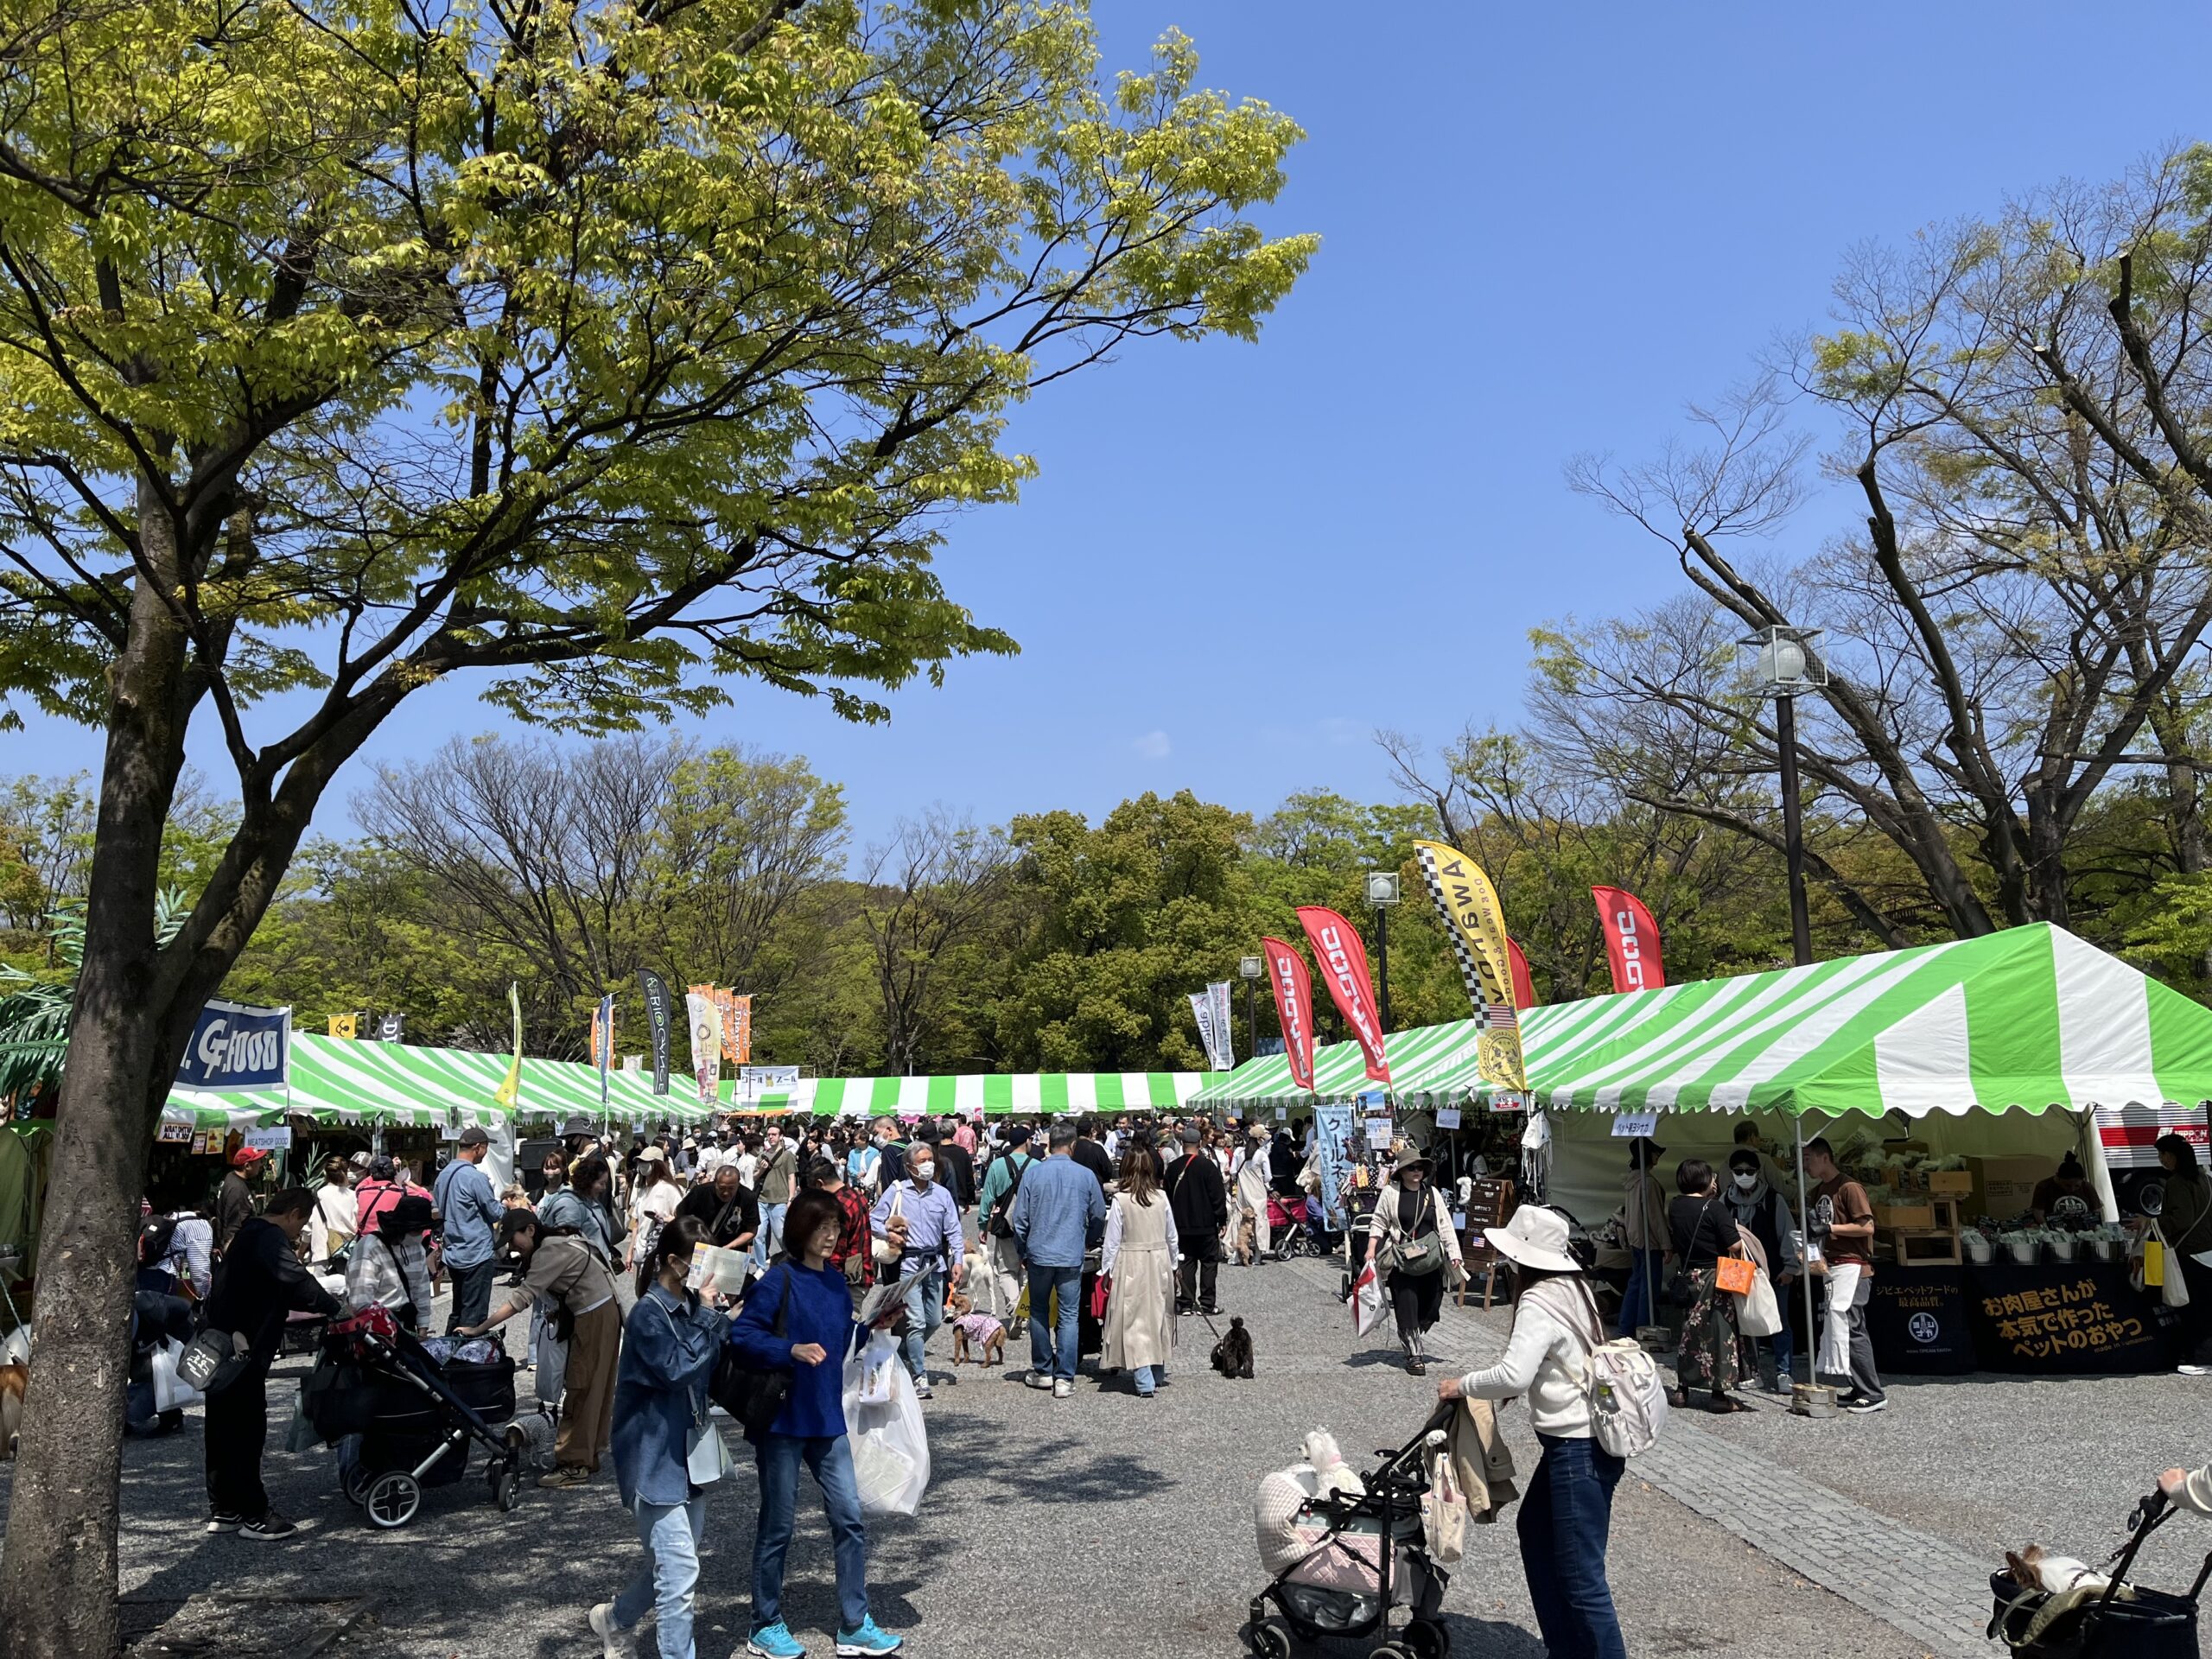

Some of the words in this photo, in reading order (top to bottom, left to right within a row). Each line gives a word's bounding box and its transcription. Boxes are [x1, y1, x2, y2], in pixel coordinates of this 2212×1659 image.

[247, 1137, 274, 1146] MEATSHOP
[1982, 1278, 2097, 1317] お肉屋さんが
[1996, 1301, 2114, 1340] 本気で作った
[2013, 1318, 2142, 1357] ペットのおやつ
